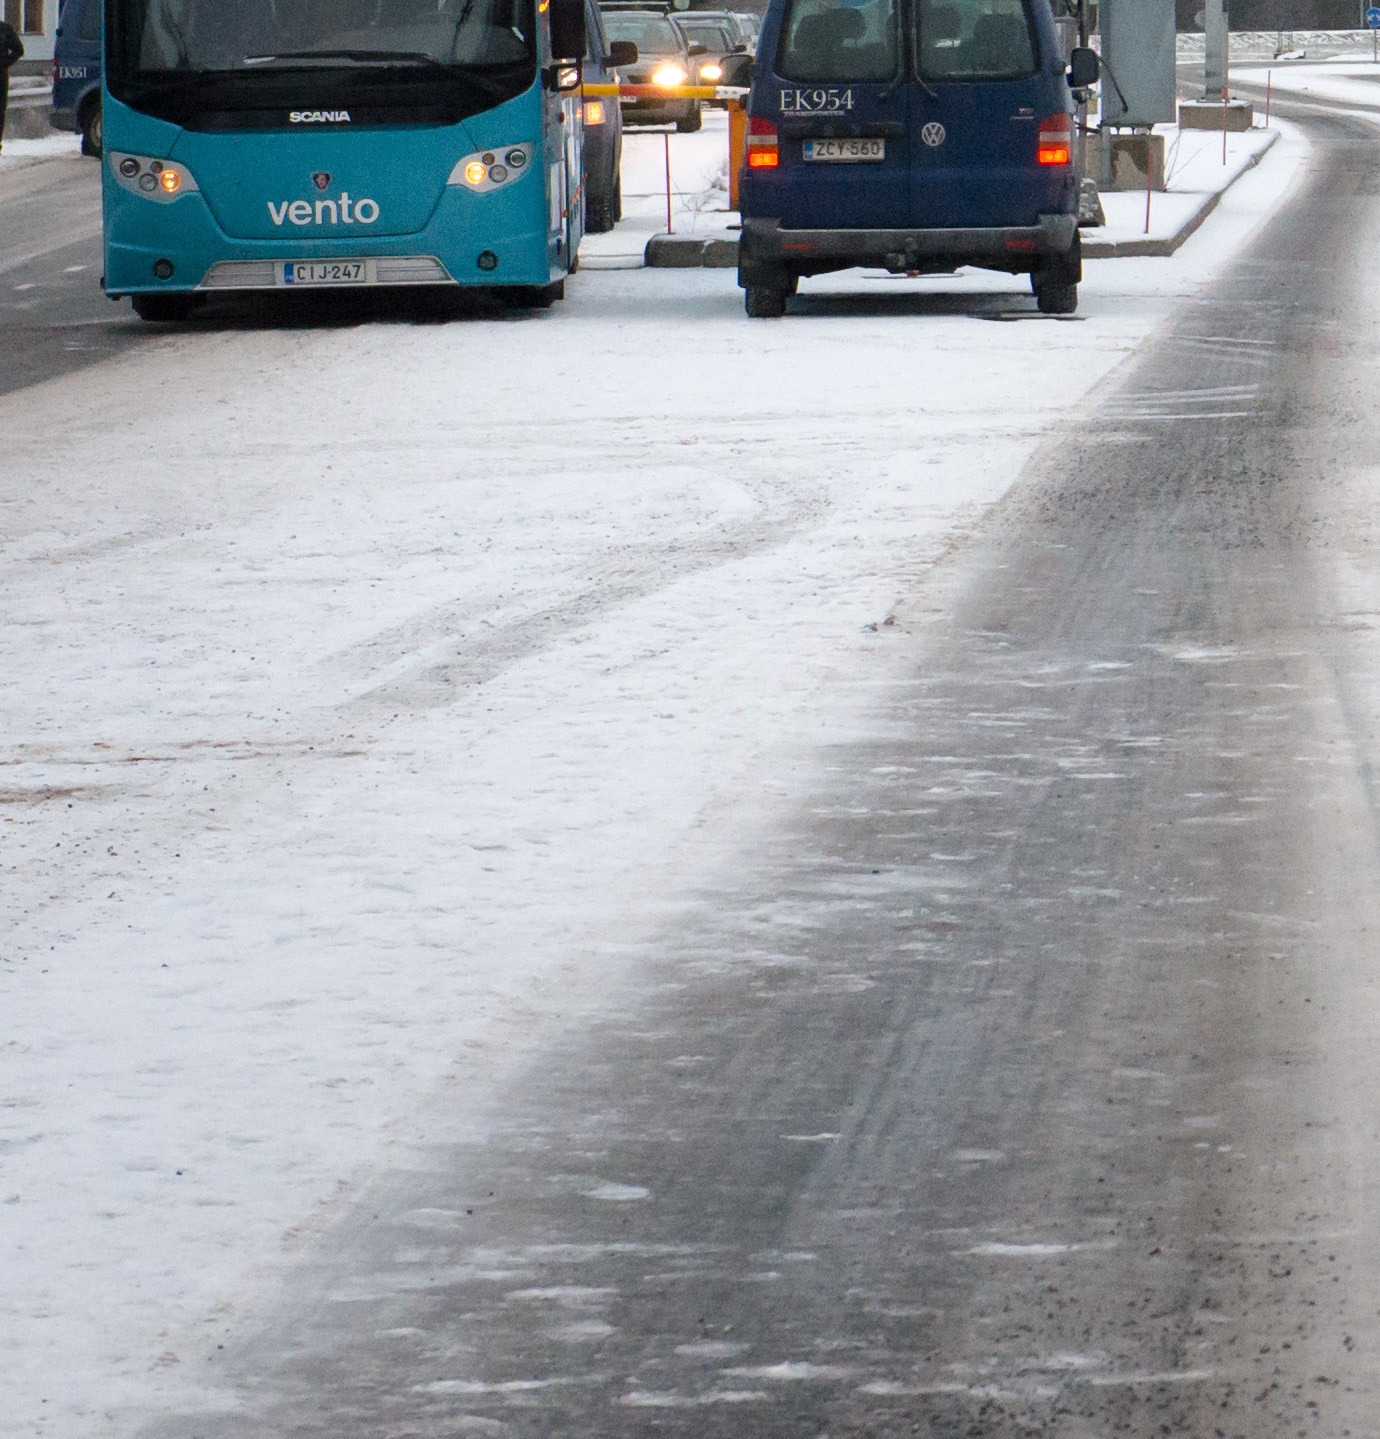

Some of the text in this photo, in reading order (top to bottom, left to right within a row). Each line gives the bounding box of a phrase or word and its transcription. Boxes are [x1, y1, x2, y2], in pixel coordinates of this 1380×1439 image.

[779, 89, 855, 111] EK954
[289, 110, 350, 123] SCANIA
[266, 191, 380, 226] vento
